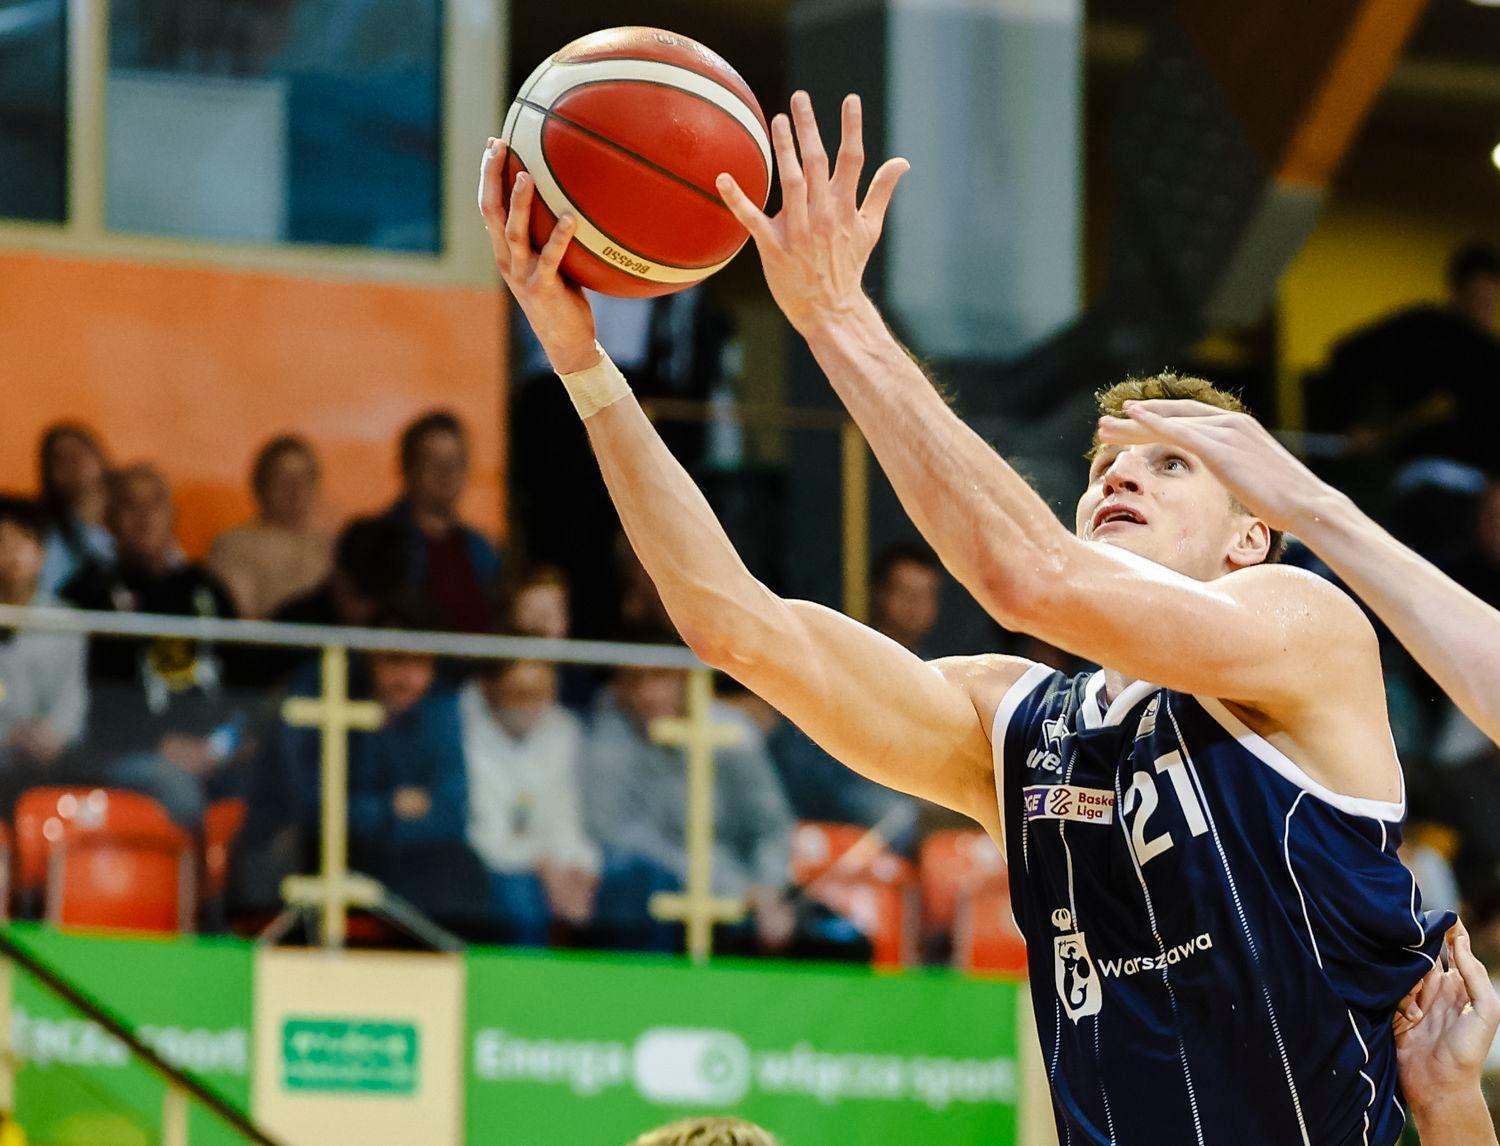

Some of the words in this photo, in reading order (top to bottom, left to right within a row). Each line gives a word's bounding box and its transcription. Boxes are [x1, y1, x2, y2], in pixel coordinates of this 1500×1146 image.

[1076, 805, 1103, 819] Liga
[1123, 749, 1209, 867] 21
[1097, 932, 1213, 978] Warszawa
